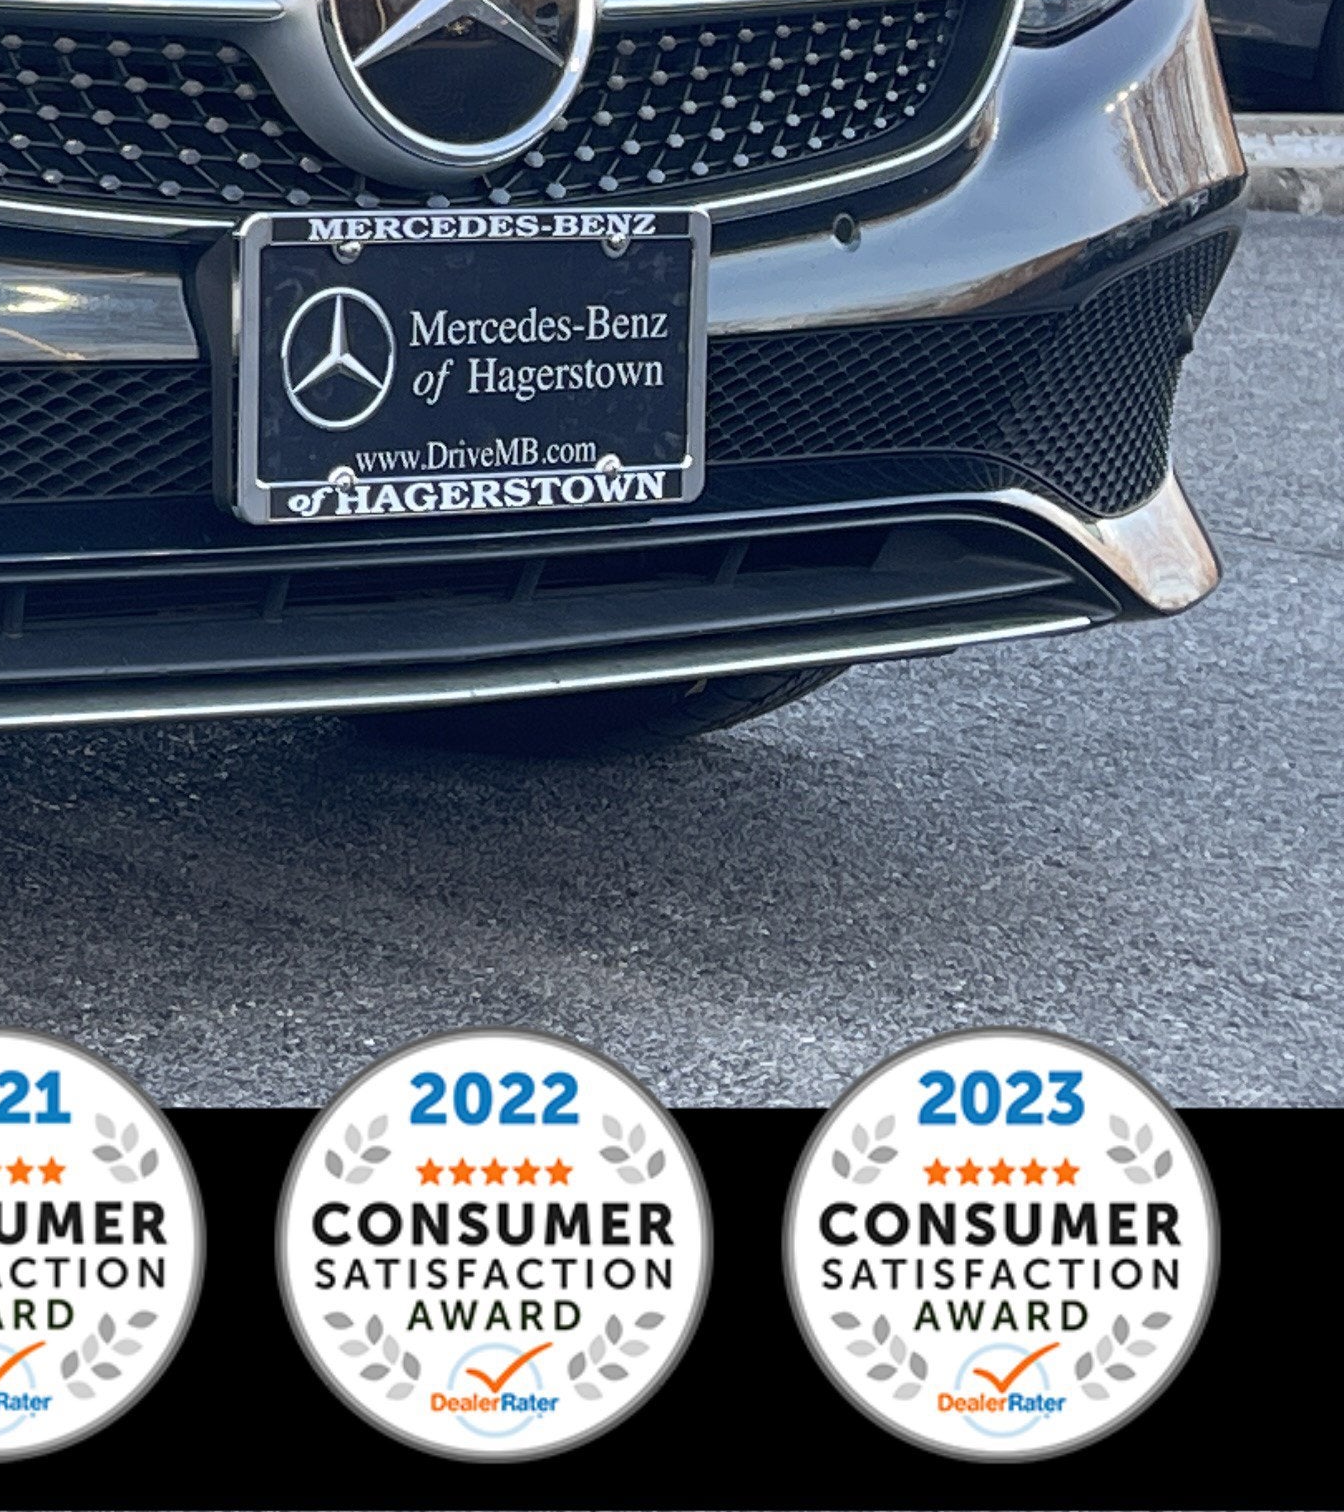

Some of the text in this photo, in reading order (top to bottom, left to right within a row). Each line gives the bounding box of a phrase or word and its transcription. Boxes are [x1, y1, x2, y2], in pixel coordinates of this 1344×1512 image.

[308, 213, 657, 242] MERCEDES-BENZ
[409, 304, 669, 347] Mercedes-Benz
[412, 358, 664, 405] of Hagerstown
[355, 436, 597, 474] www.DriveMB.com
[288, 471, 666, 517] of HAGERSTOWN
